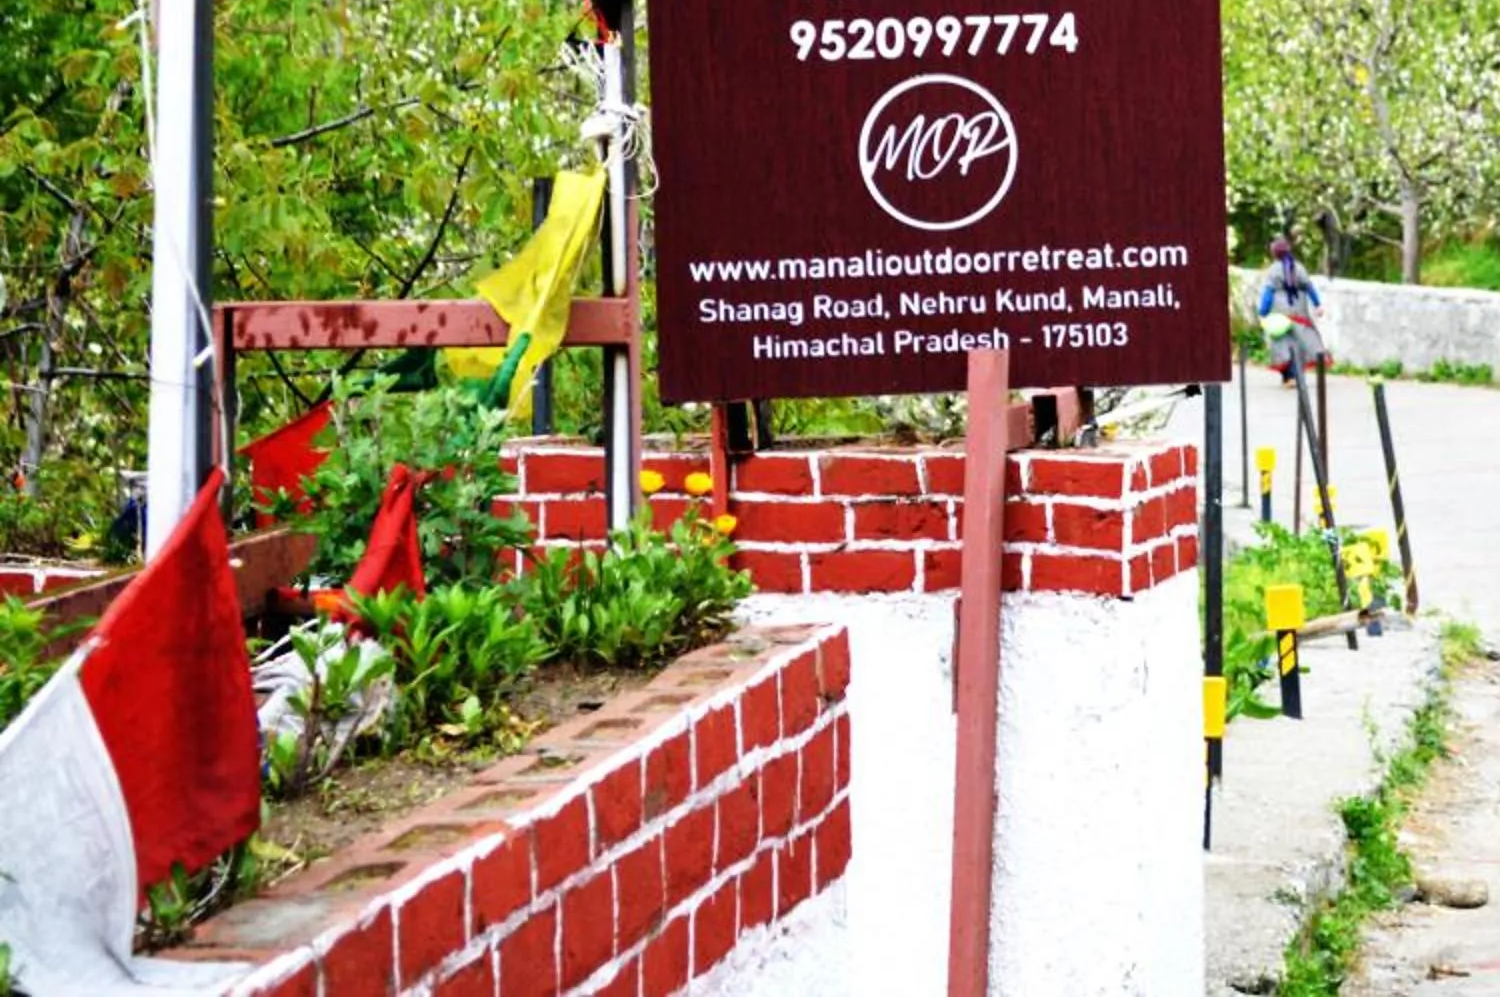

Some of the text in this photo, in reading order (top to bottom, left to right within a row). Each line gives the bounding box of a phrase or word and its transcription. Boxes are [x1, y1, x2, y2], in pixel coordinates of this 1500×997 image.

[789, 12, 1079, 62] 9520997774
[689, 243, 1188, 282] www.manalioutdoorretreat.com
[699, 283, 1181, 326] Shanag Road, Nehru Kund, Manali,
[753, 331, 885, 359] Himachal
[894, 327, 1010, 354] Pradesh
[1041, 322, 1129, 348] 175103
